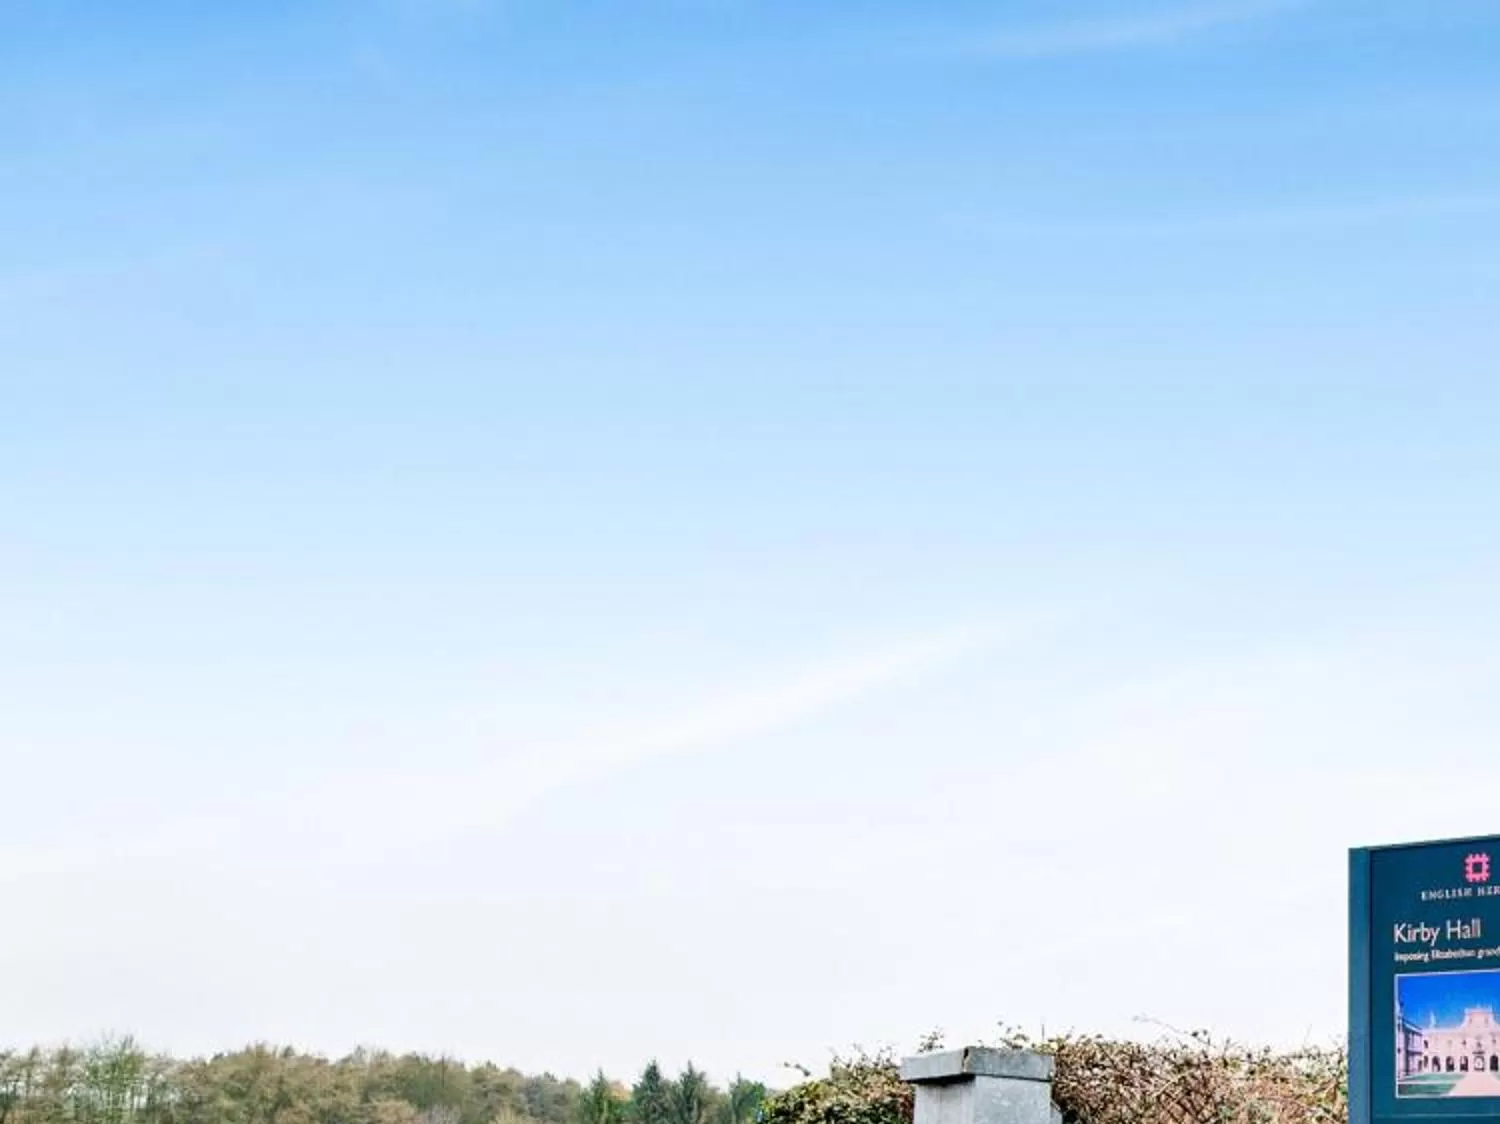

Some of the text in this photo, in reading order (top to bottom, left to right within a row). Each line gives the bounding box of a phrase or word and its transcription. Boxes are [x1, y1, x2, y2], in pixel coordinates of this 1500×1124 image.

[1421, 887, 1472, 901] ENGLISH
[1393, 918, 1481, 946] Kirby Hall
